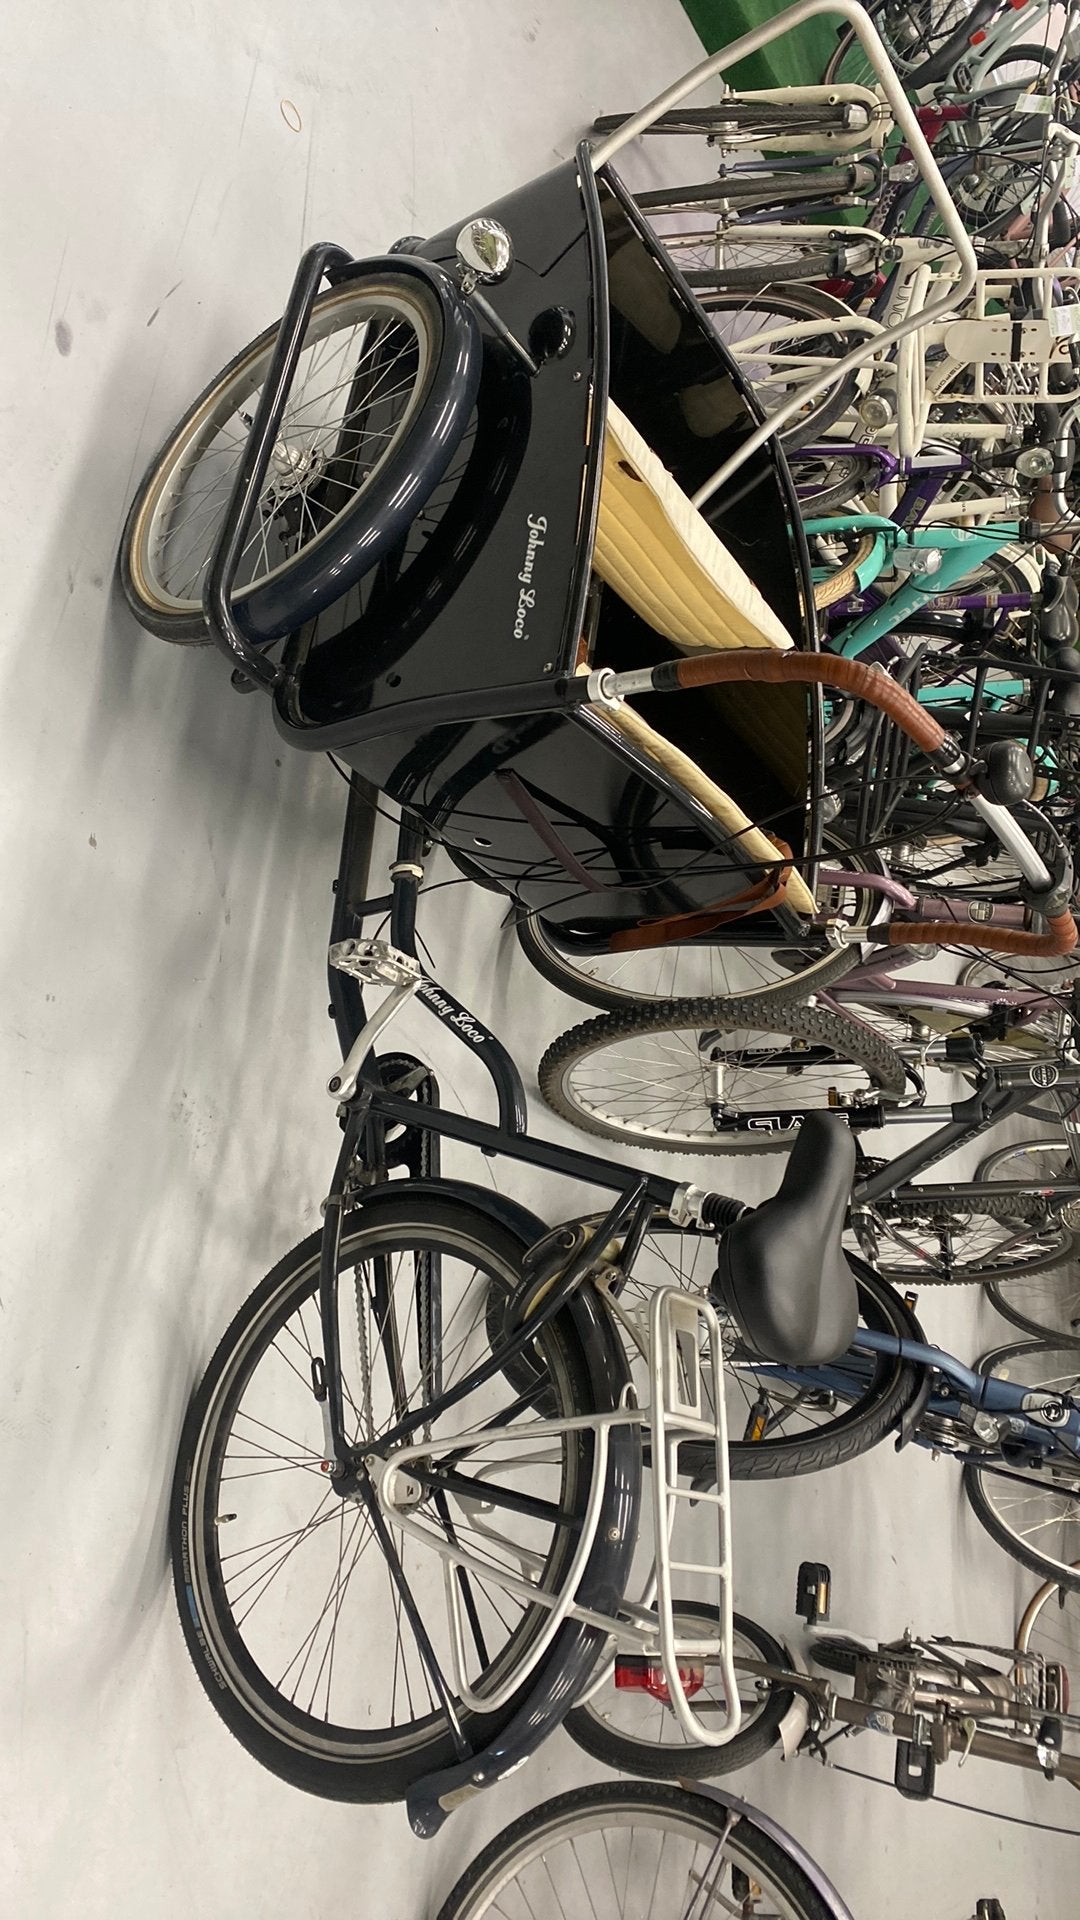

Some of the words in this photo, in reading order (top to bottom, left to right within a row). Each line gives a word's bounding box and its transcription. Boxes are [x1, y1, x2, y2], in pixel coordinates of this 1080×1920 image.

[518, 513, 548, 584] Johnny
[181, 1485, 190, 1516] PLUS
[181, 1521, 191, 1583] MARATHON
[196, 1630, 228, 1690] SCHWALBE
